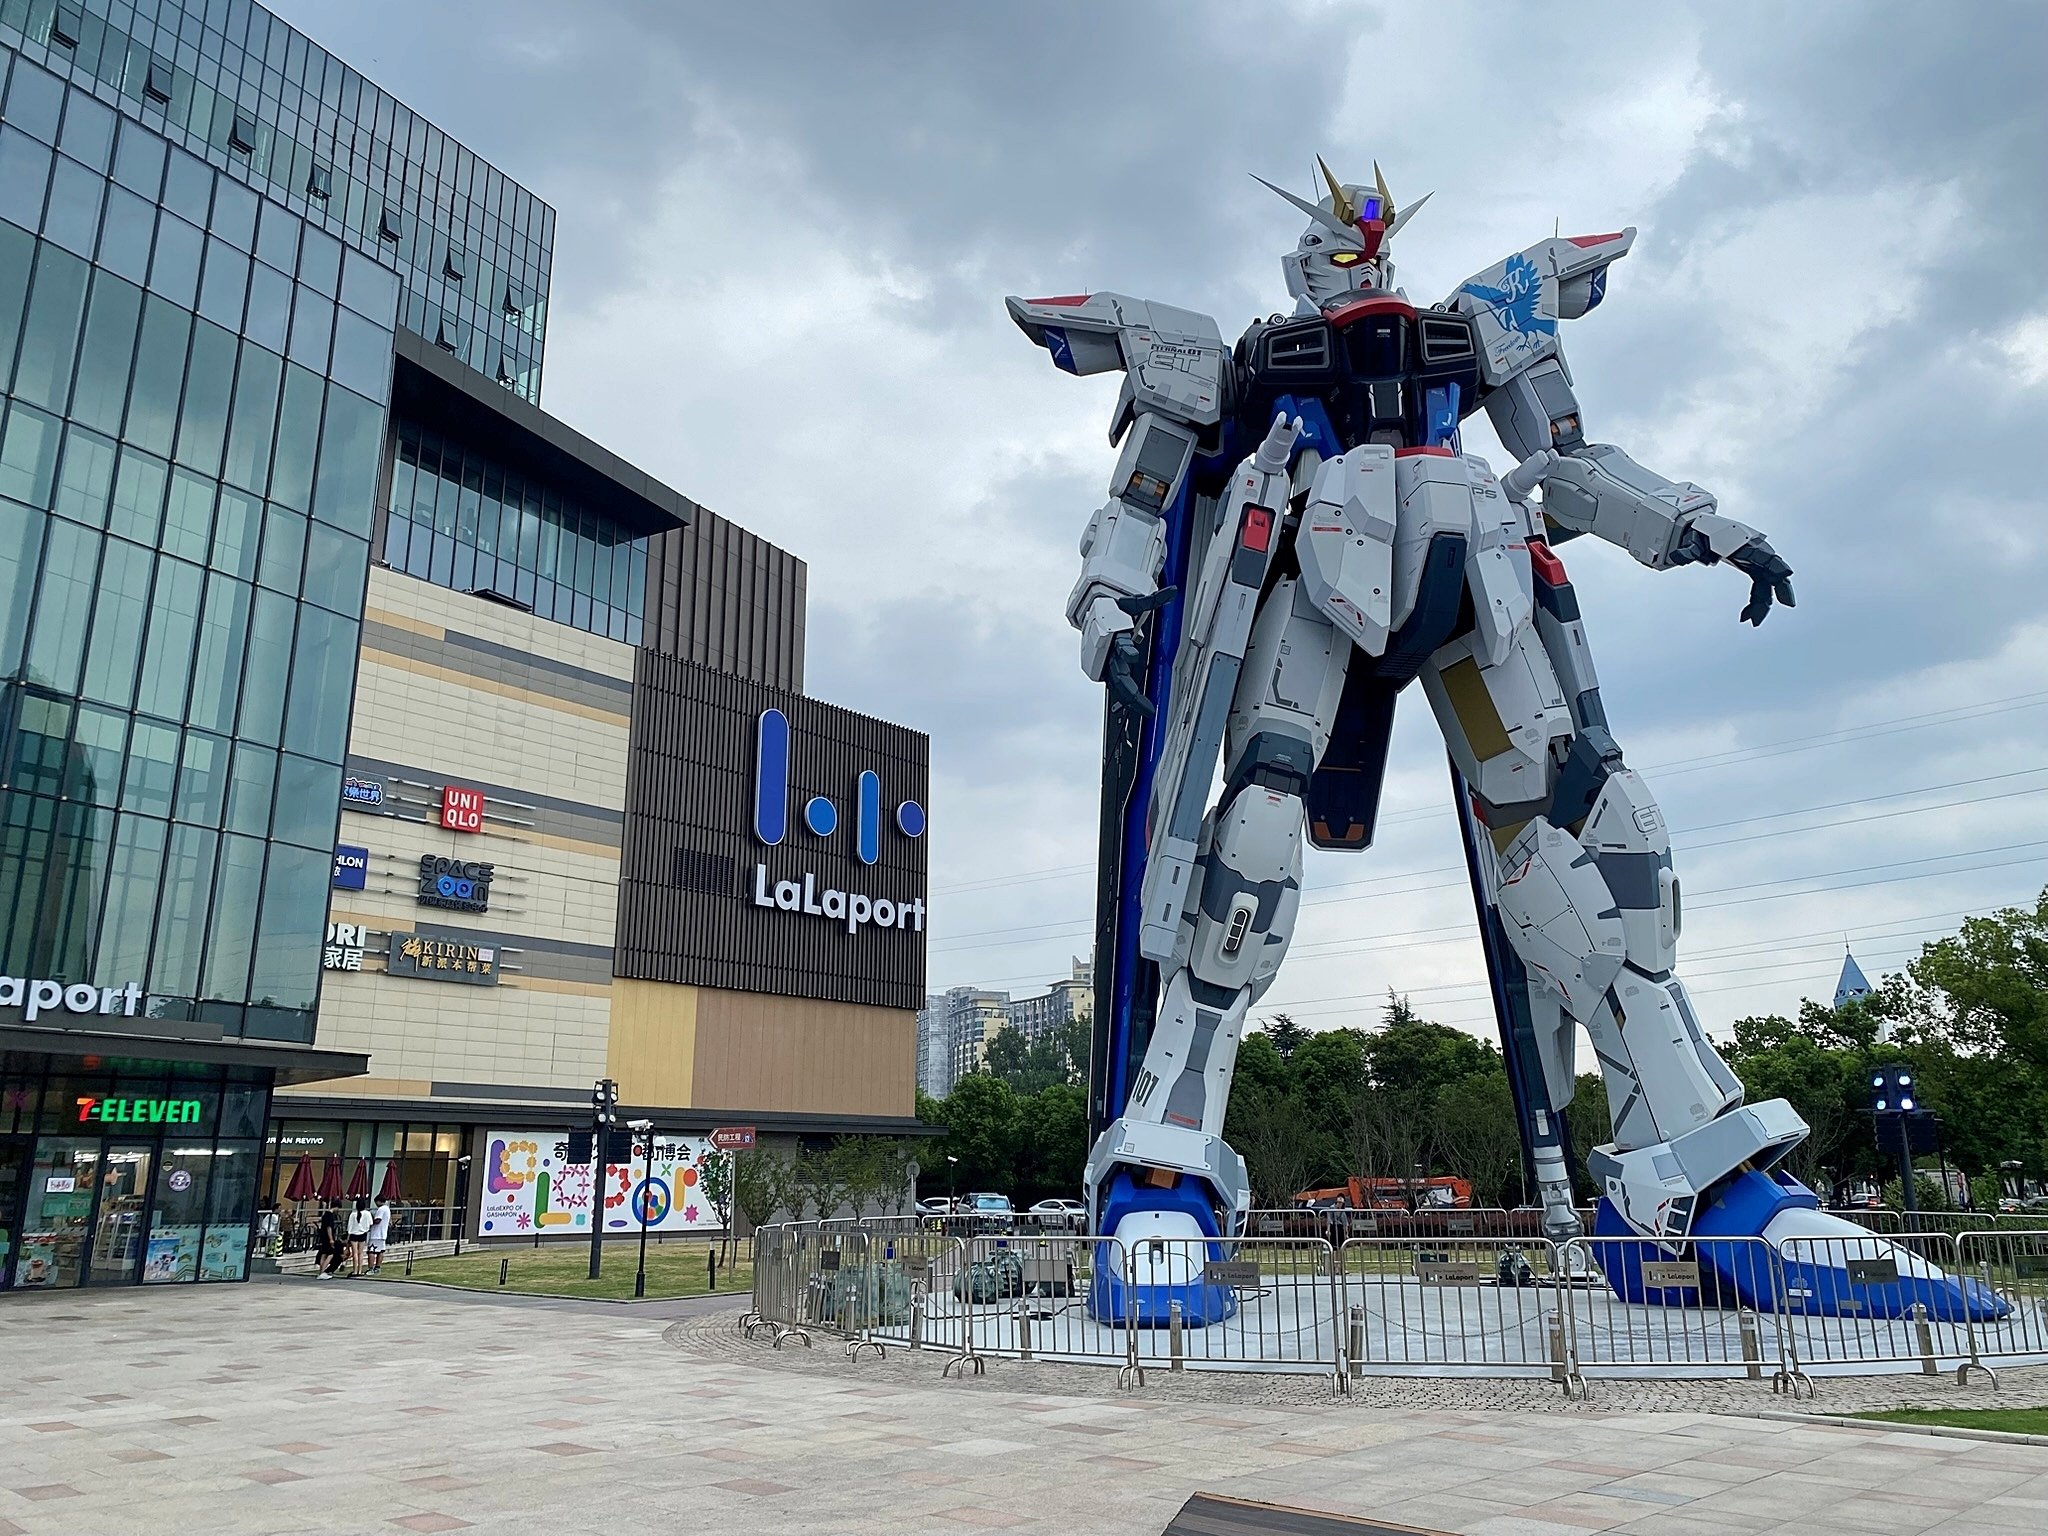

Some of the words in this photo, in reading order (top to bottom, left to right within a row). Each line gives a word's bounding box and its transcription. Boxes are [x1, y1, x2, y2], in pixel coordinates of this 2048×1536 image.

[448, 790, 478, 810] UNI
[446, 808, 479, 828] QLO
[420, 853, 495, 882] SPACE
[755, 863, 926, 935] LaLaport
[323, 945, 364, 972] 家居
[422, 940, 479, 961] KIRIN
[421, 955, 492, 975] 新派本帮菜
[0, 975, 143, 1022] aport
[295, 1137, 324, 1145] REVIVO
